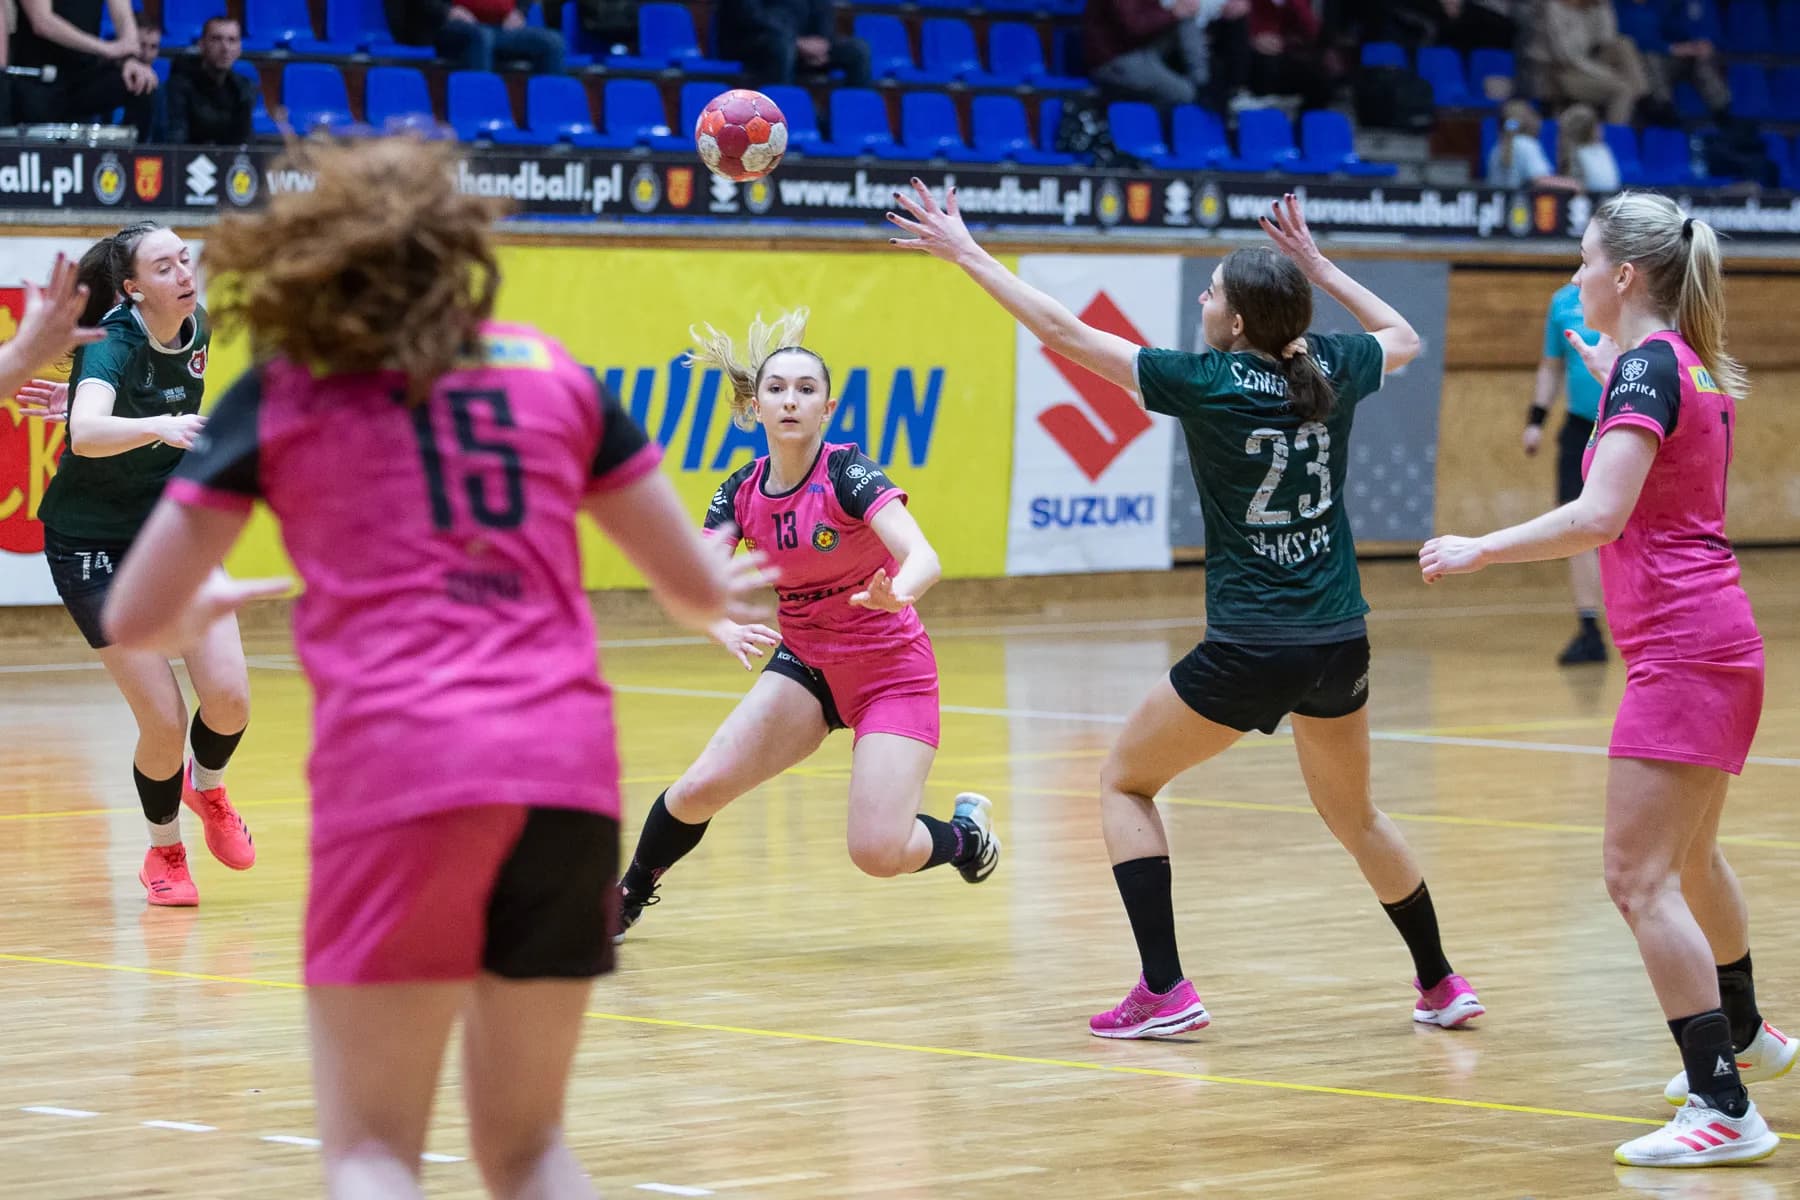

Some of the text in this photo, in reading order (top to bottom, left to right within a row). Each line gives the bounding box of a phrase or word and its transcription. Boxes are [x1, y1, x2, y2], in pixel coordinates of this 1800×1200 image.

[389, 388, 526, 531] 15
[1244, 421, 1333, 525] 23
[771, 510, 799, 551] 13
[1030, 494, 1155, 529] SUZUKI
